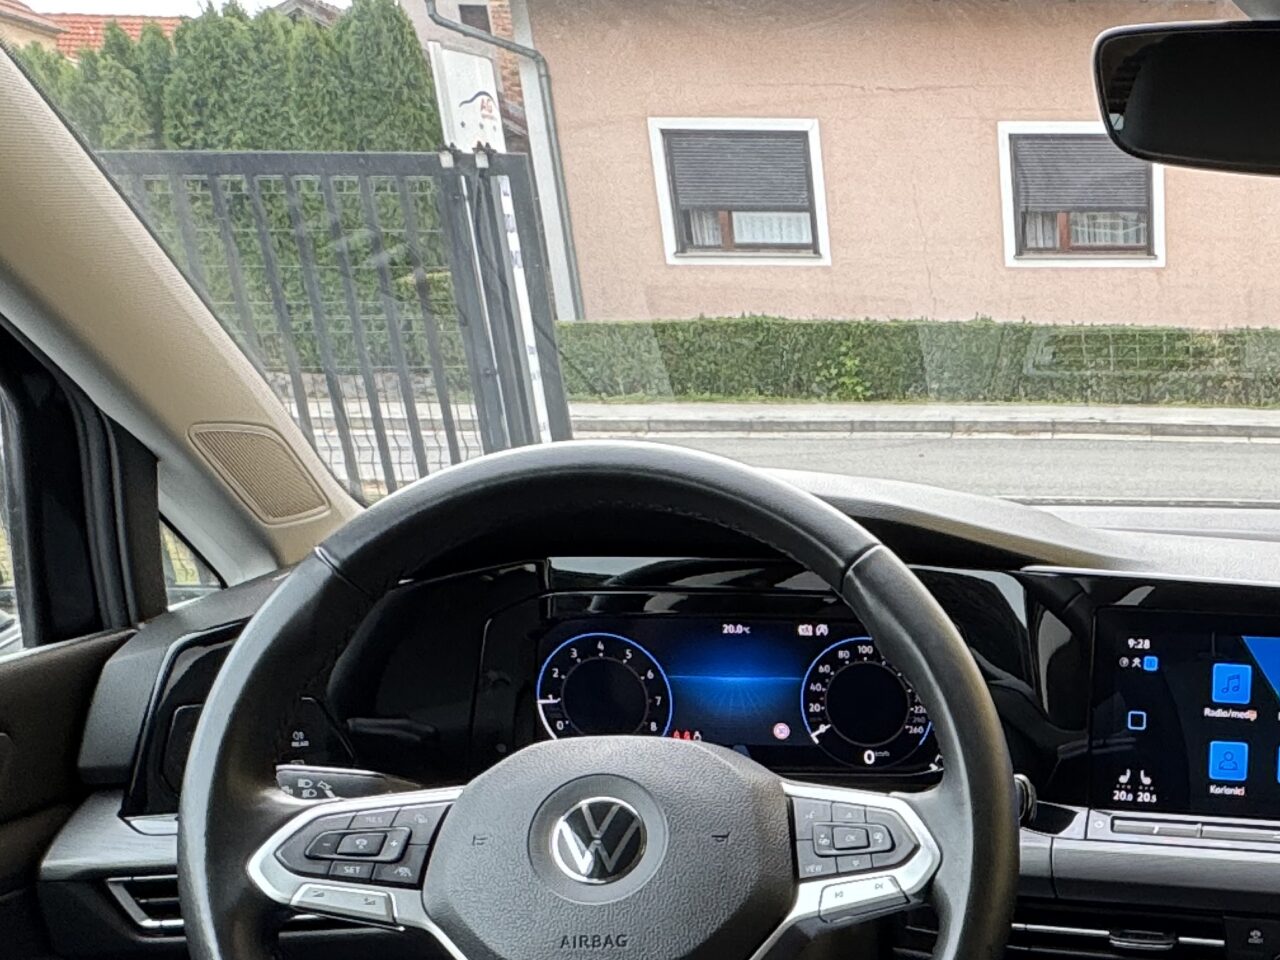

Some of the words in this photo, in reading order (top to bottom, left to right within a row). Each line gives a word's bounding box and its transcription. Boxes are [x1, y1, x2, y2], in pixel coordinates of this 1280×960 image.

[597, 641, 604, 650] 4
[1128, 638, 1151, 650] 9:28
[570, 648, 577, 658] 3
[857, 645, 873, 654] 100
[625, 650, 632, 659] 5
[838, 650, 850, 659] 80
[552, 668, 559, 678] 2
[818, 665, 830, 673] 60
[647, 670, 654, 679] 6
[810, 683, 822, 691] 40
[655, 696, 662, 705] 7
[809, 703, 821, 712] 20
[556, 721, 564, 731] 0
[650, 722, 657, 731] 8
[908, 725, 924, 734] 260
[863, 750, 875, 765] 0
[343, 866, 361, 874] SET
[805, 864, 823, 873] VIEW
[560, 934, 628, 949] AIRBAG
